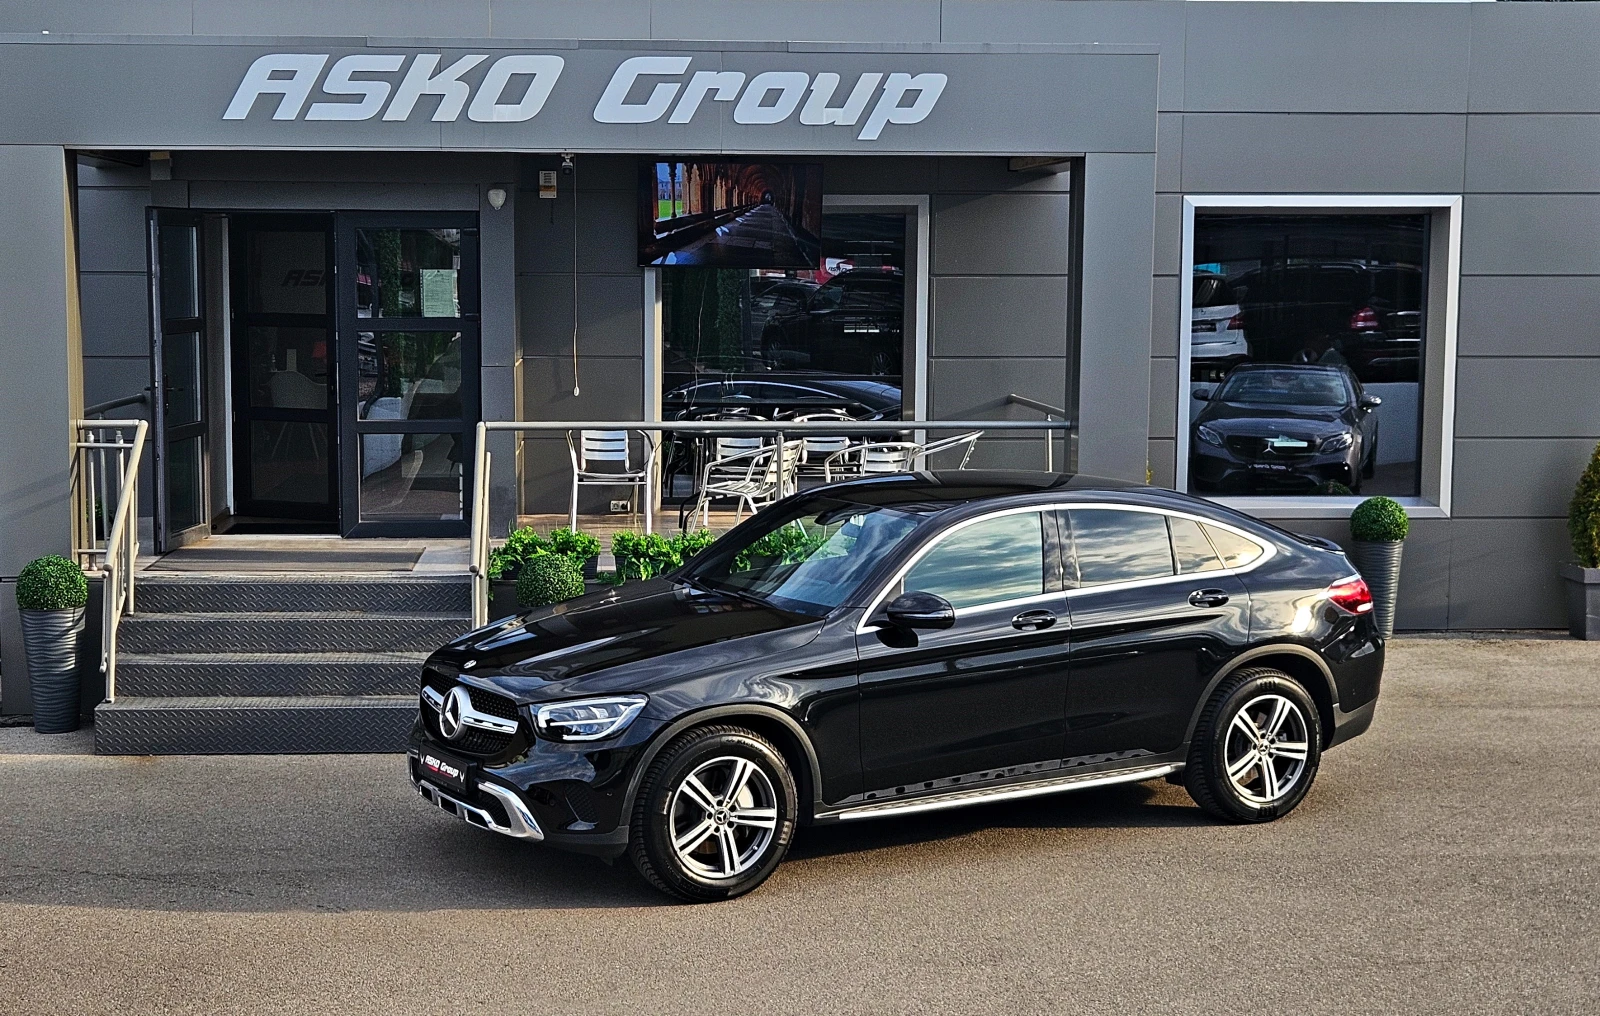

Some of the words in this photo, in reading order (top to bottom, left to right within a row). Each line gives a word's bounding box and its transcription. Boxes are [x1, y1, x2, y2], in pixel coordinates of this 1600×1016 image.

[222, 53, 565, 122] ASKO
[593, 56, 948, 140] Group
[424, 754, 441, 769] ASKO
[440, 762, 459, 778] Group
